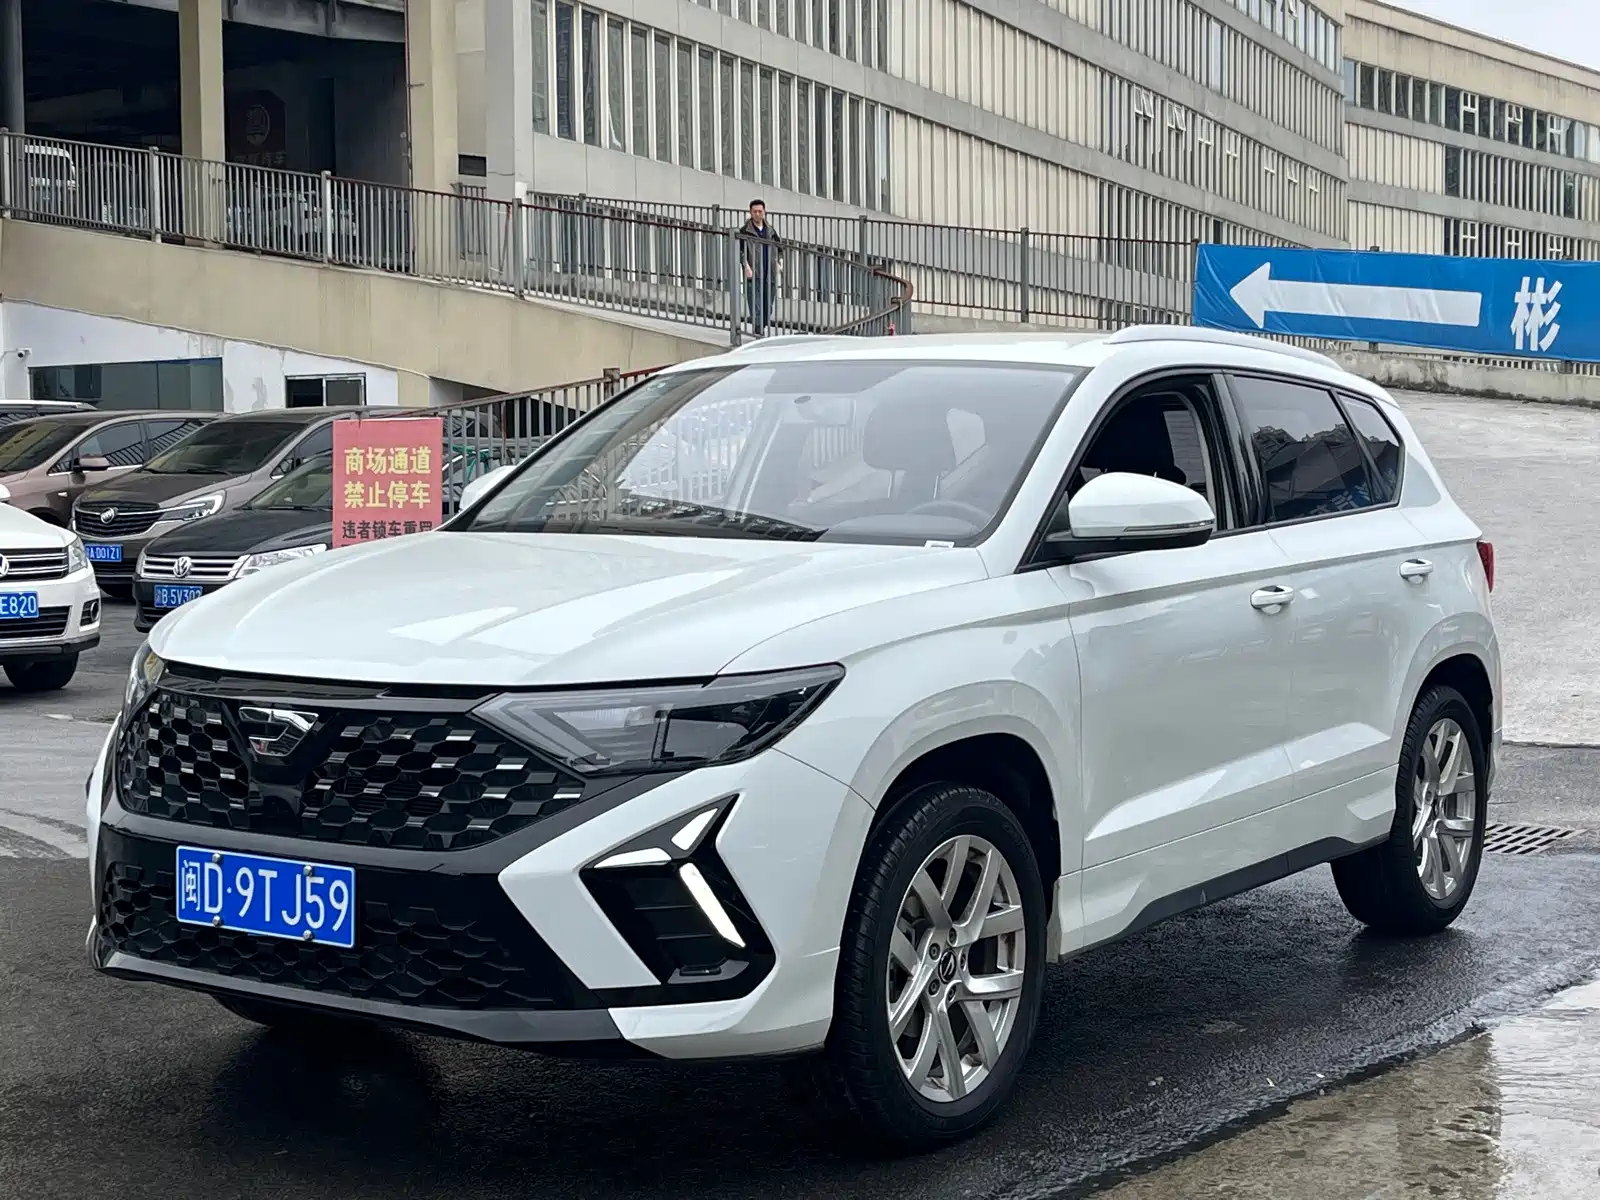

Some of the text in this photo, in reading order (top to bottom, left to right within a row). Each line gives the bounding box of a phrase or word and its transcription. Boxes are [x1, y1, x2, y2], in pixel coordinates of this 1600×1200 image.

[1510, 276, 1563, 352] 彬
[343, 446, 432, 475] 商场通道
[343, 480, 432, 509] 禁止停车
[0, 595, 37, 614] E820
[181, 859, 349, 932] 闽D·9TJ59
